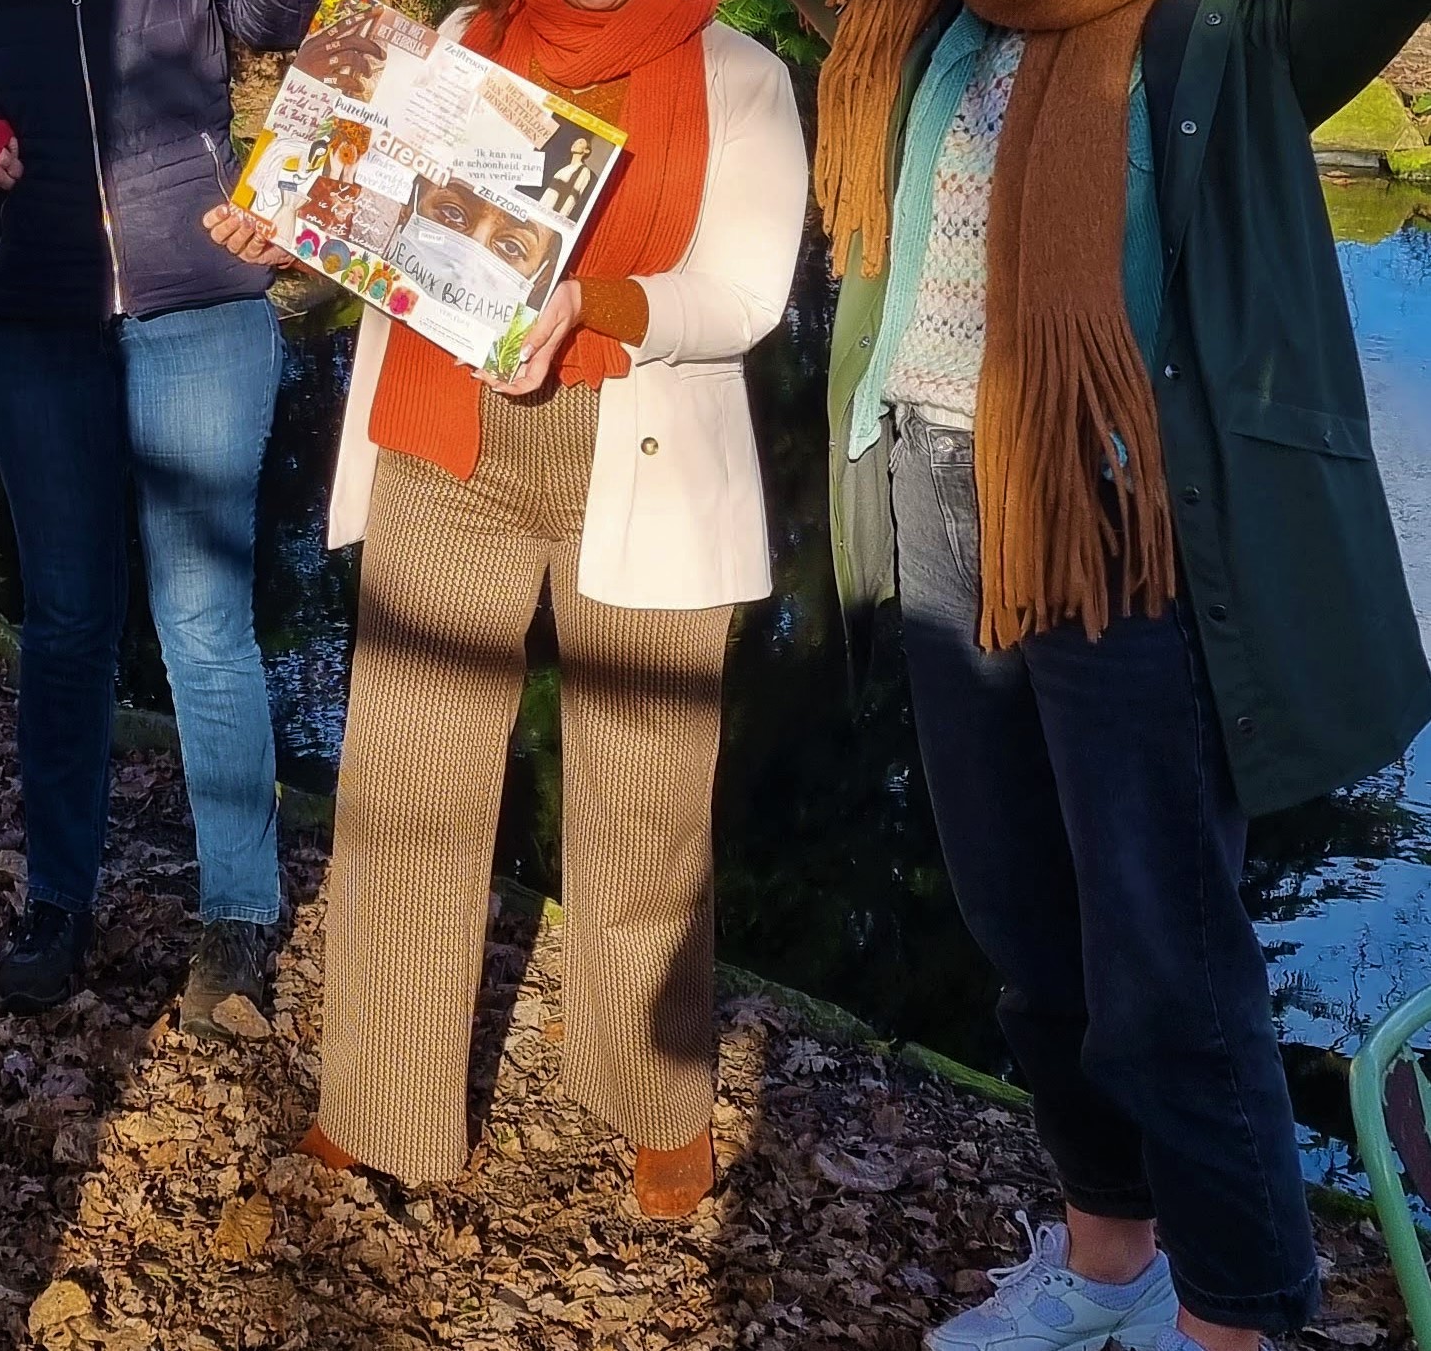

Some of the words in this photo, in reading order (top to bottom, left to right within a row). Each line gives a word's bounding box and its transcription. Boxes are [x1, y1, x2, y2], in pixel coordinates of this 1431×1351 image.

[444, 42, 489, 73] Zelftroost
[483, 91, 516, 122] DINGEN
[515, 119, 539, 142] DOEN
[485, 76, 504, 94] VAN
[503, 92, 551, 139] NUTTELOZE
[505, 83, 523, 99] HET
[524, 98, 543, 118] NUT
[374, 130, 453, 189] dream
[452, 158, 464, 167] de
[467, 158, 519, 171] schoonheid
[522, 163, 542, 172] zien
[489, 149, 507, 159] kan
[468, 171, 486, 180] van
[478, 185, 528, 219] ZELFZORG
[441, 282, 514, 323] BREATHE
